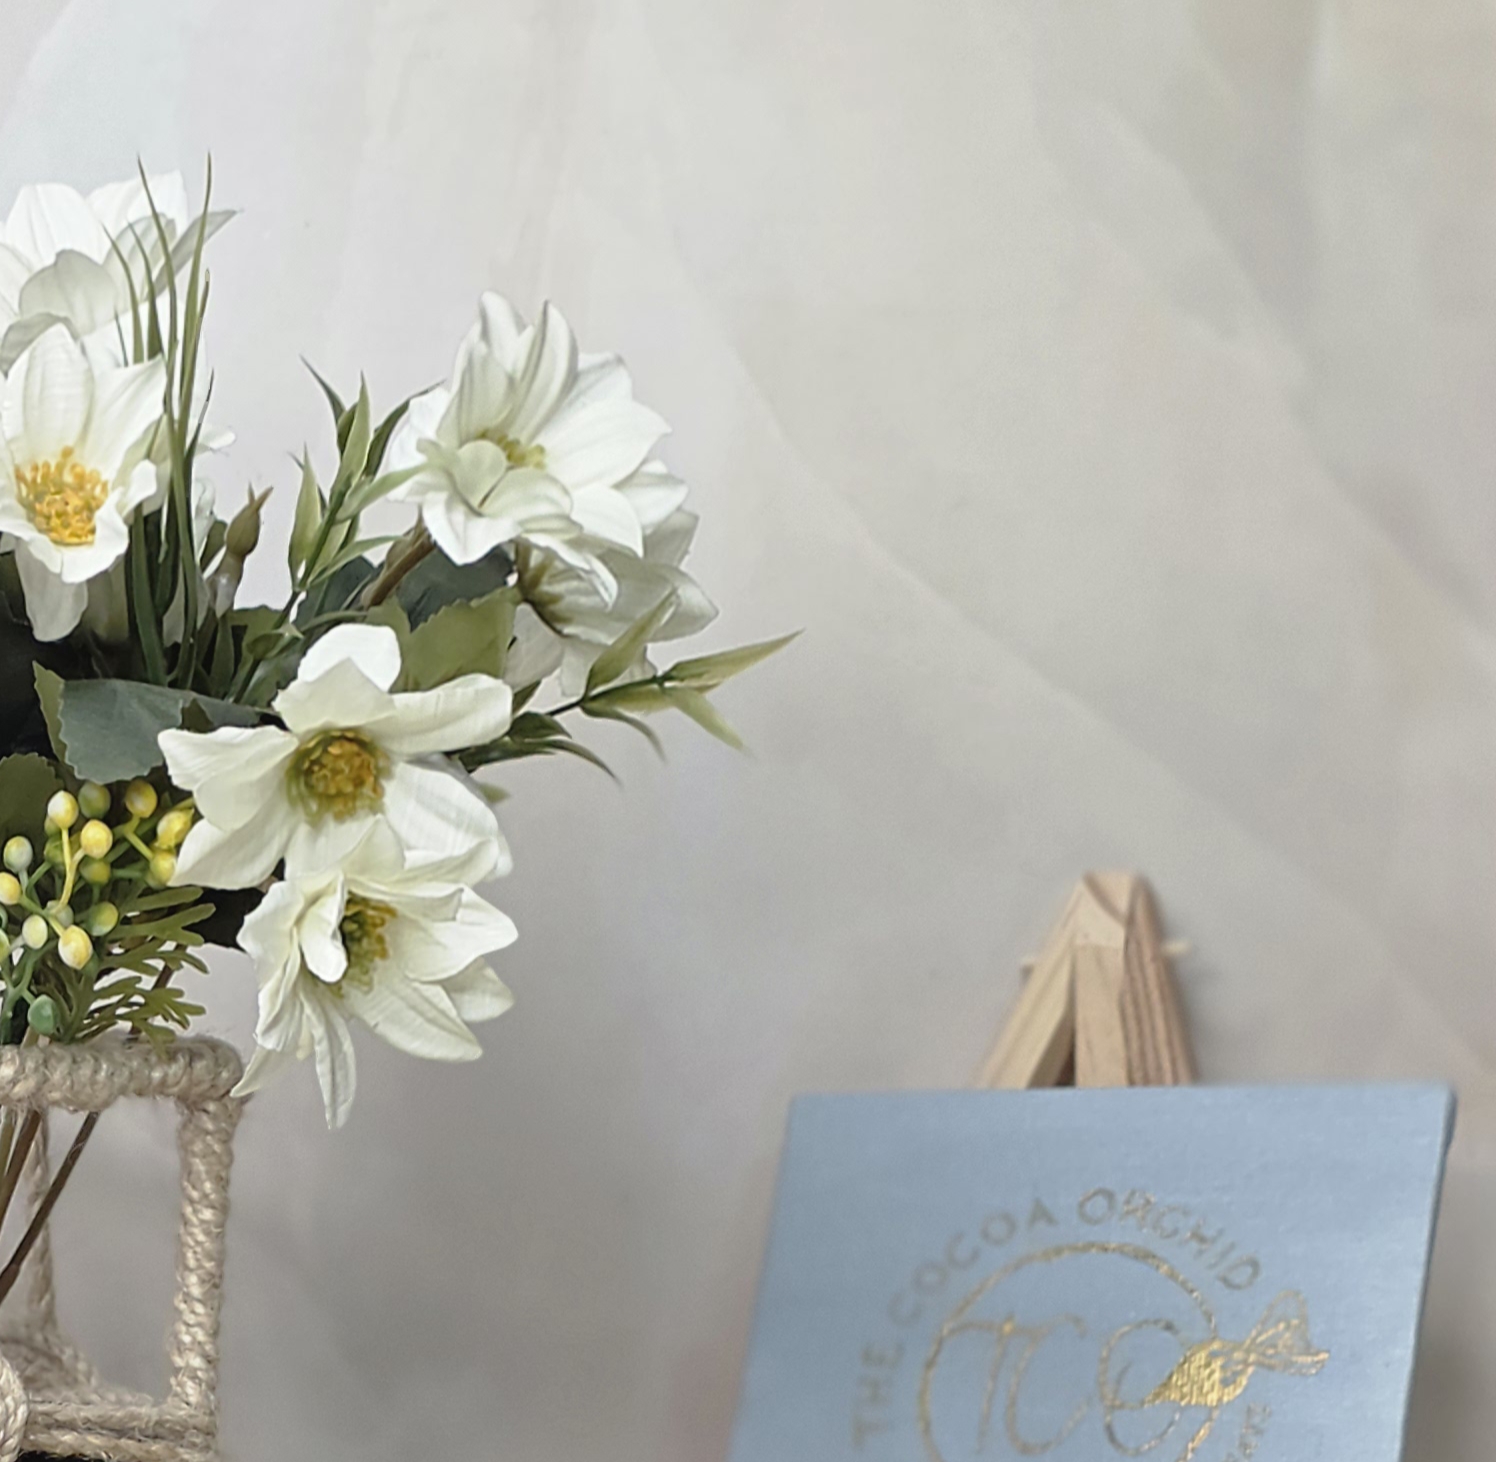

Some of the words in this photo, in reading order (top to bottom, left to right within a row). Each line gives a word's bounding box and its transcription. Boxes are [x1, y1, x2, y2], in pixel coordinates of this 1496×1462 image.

[852, 1340, 902, 1453] THE
[889, 1198, 1058, 1329] COCOA
[1077, 1186, 1262, 1292] ORCHID
